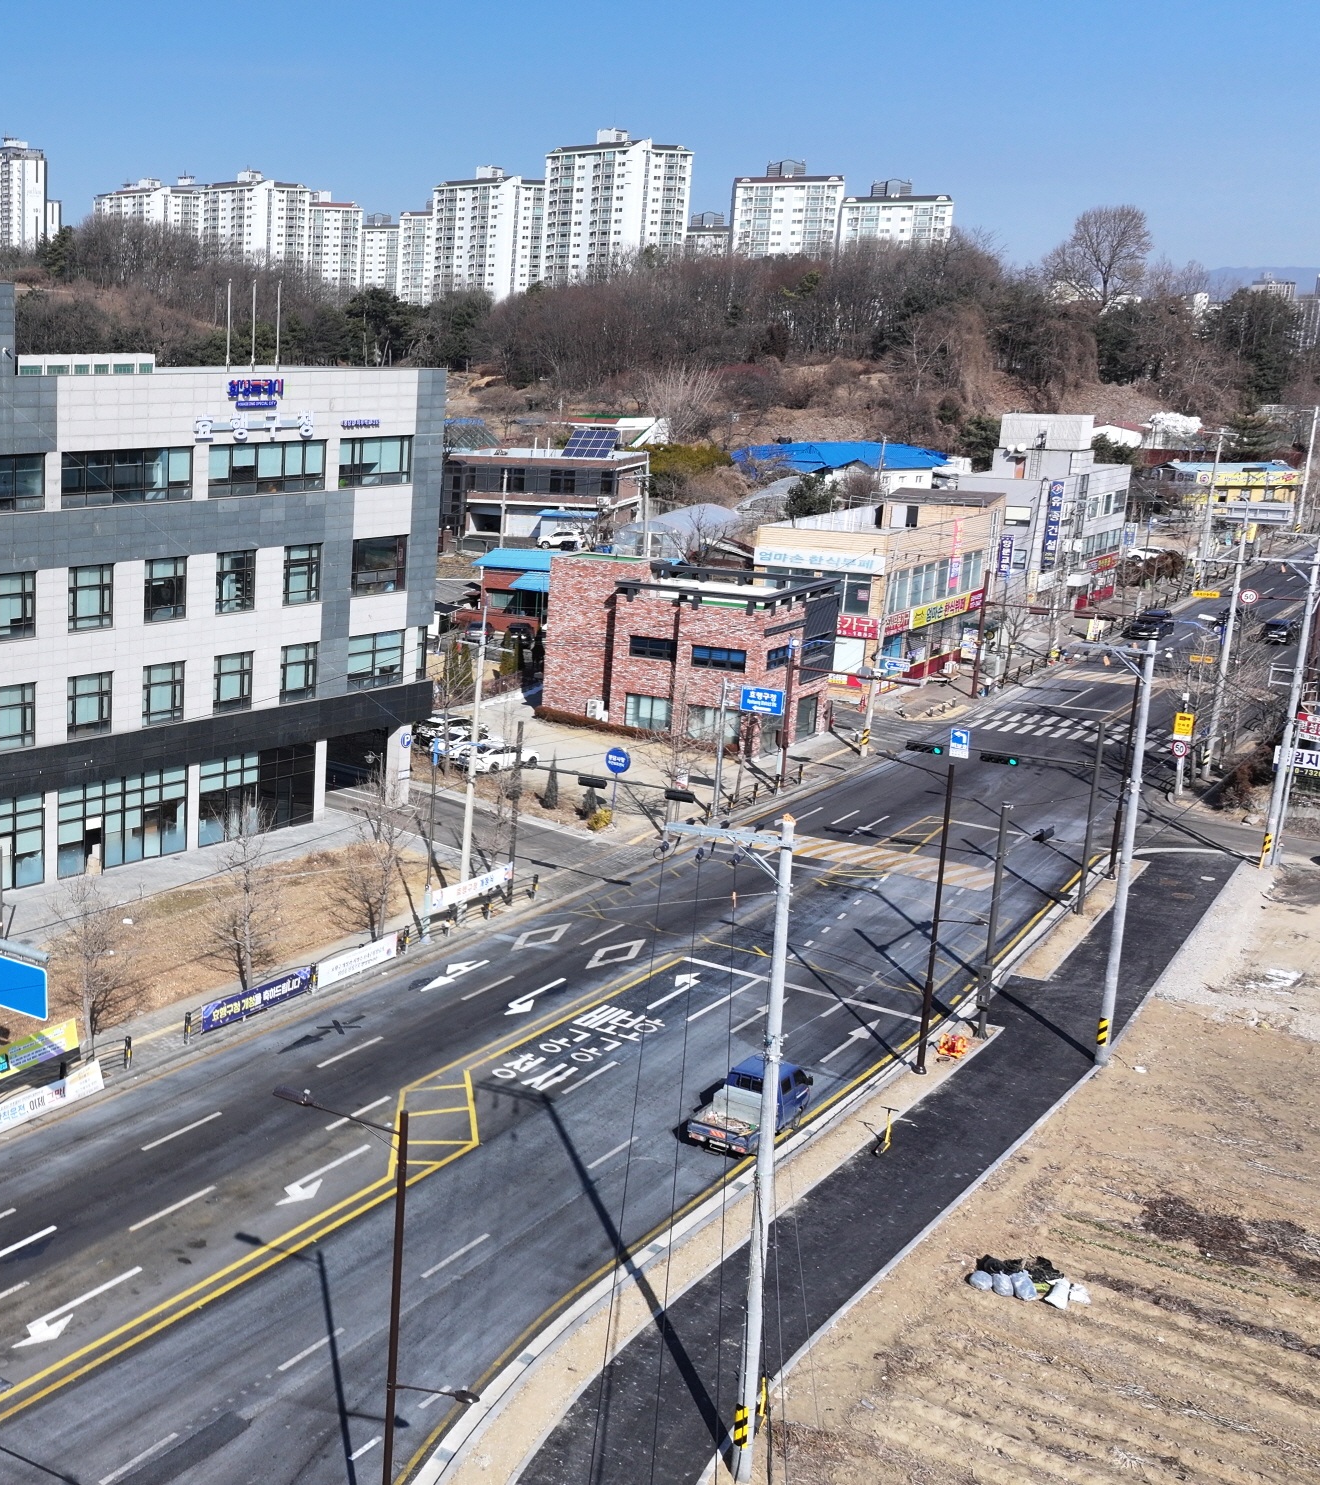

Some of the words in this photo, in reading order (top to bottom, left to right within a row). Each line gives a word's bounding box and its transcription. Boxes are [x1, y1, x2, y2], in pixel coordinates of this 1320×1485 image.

[195, 410, 314, 441] 효행구청
[758, 550, 804, 564] 엄마손
[1175, 744, 1184, 754] 50
[29, 1096, 46, 1111] 이제
